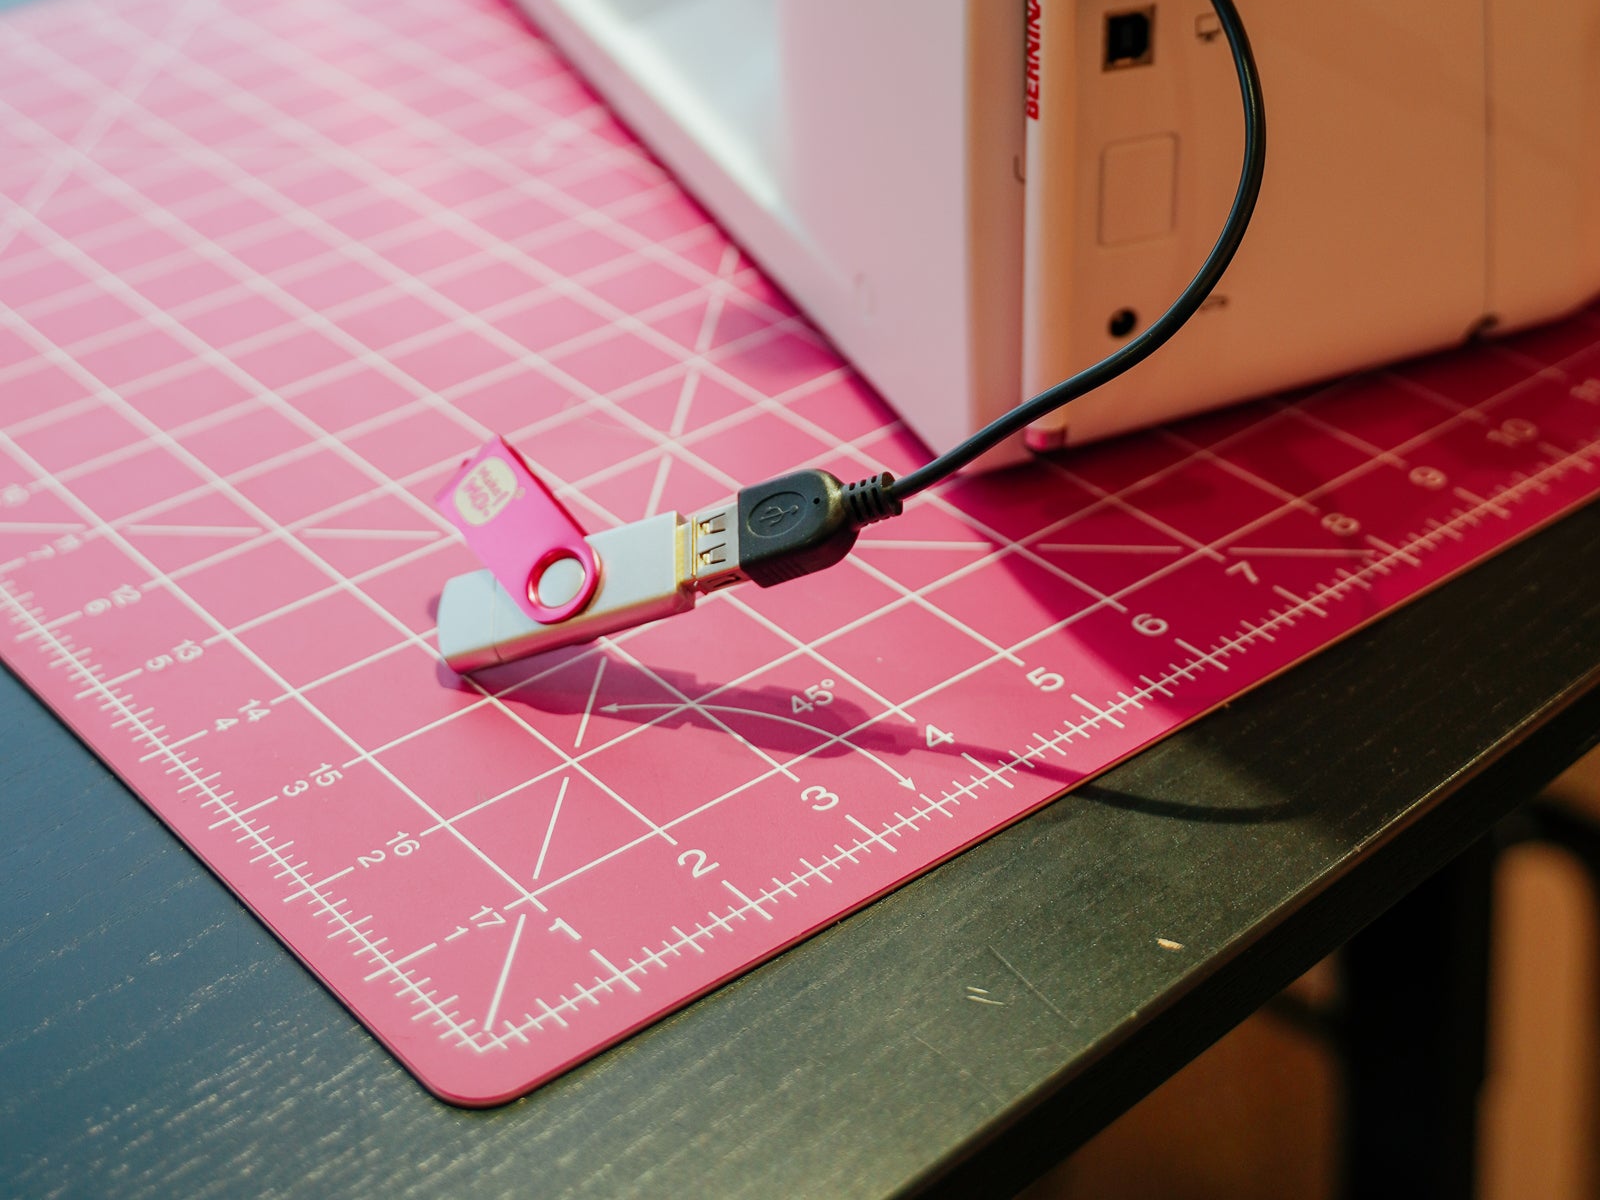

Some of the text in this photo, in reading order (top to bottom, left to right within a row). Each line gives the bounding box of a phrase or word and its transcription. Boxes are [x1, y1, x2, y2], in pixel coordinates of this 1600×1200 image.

[1321, 512, 1360, 537] 8
[1225, 561, 1259, 585] 7
[1131, 613, 1169, 636] 6
[146, 654, 174, 672] 5
[172, 639, 204, 663] 13
[1026, 666, 1065, 692] 5
[791, 678, 835, 714] 45°
[238, 698, 271, 722] 14
[215, 717, 240, 731] 4
[925, 723, 954, 748] 4
[309, 762, 344, 787] 15
[282, 780, 309, 797] 3
[800, 785, 840, 812] 3
[386, 830, 421, 857] 16
[357, 849, 386, 868] 2
[677, 848, 720, 878] 2
[470, 905, 507, 928] 17
[548, 916, 583, 941] 1
[444, 925, 469, 942] 1
